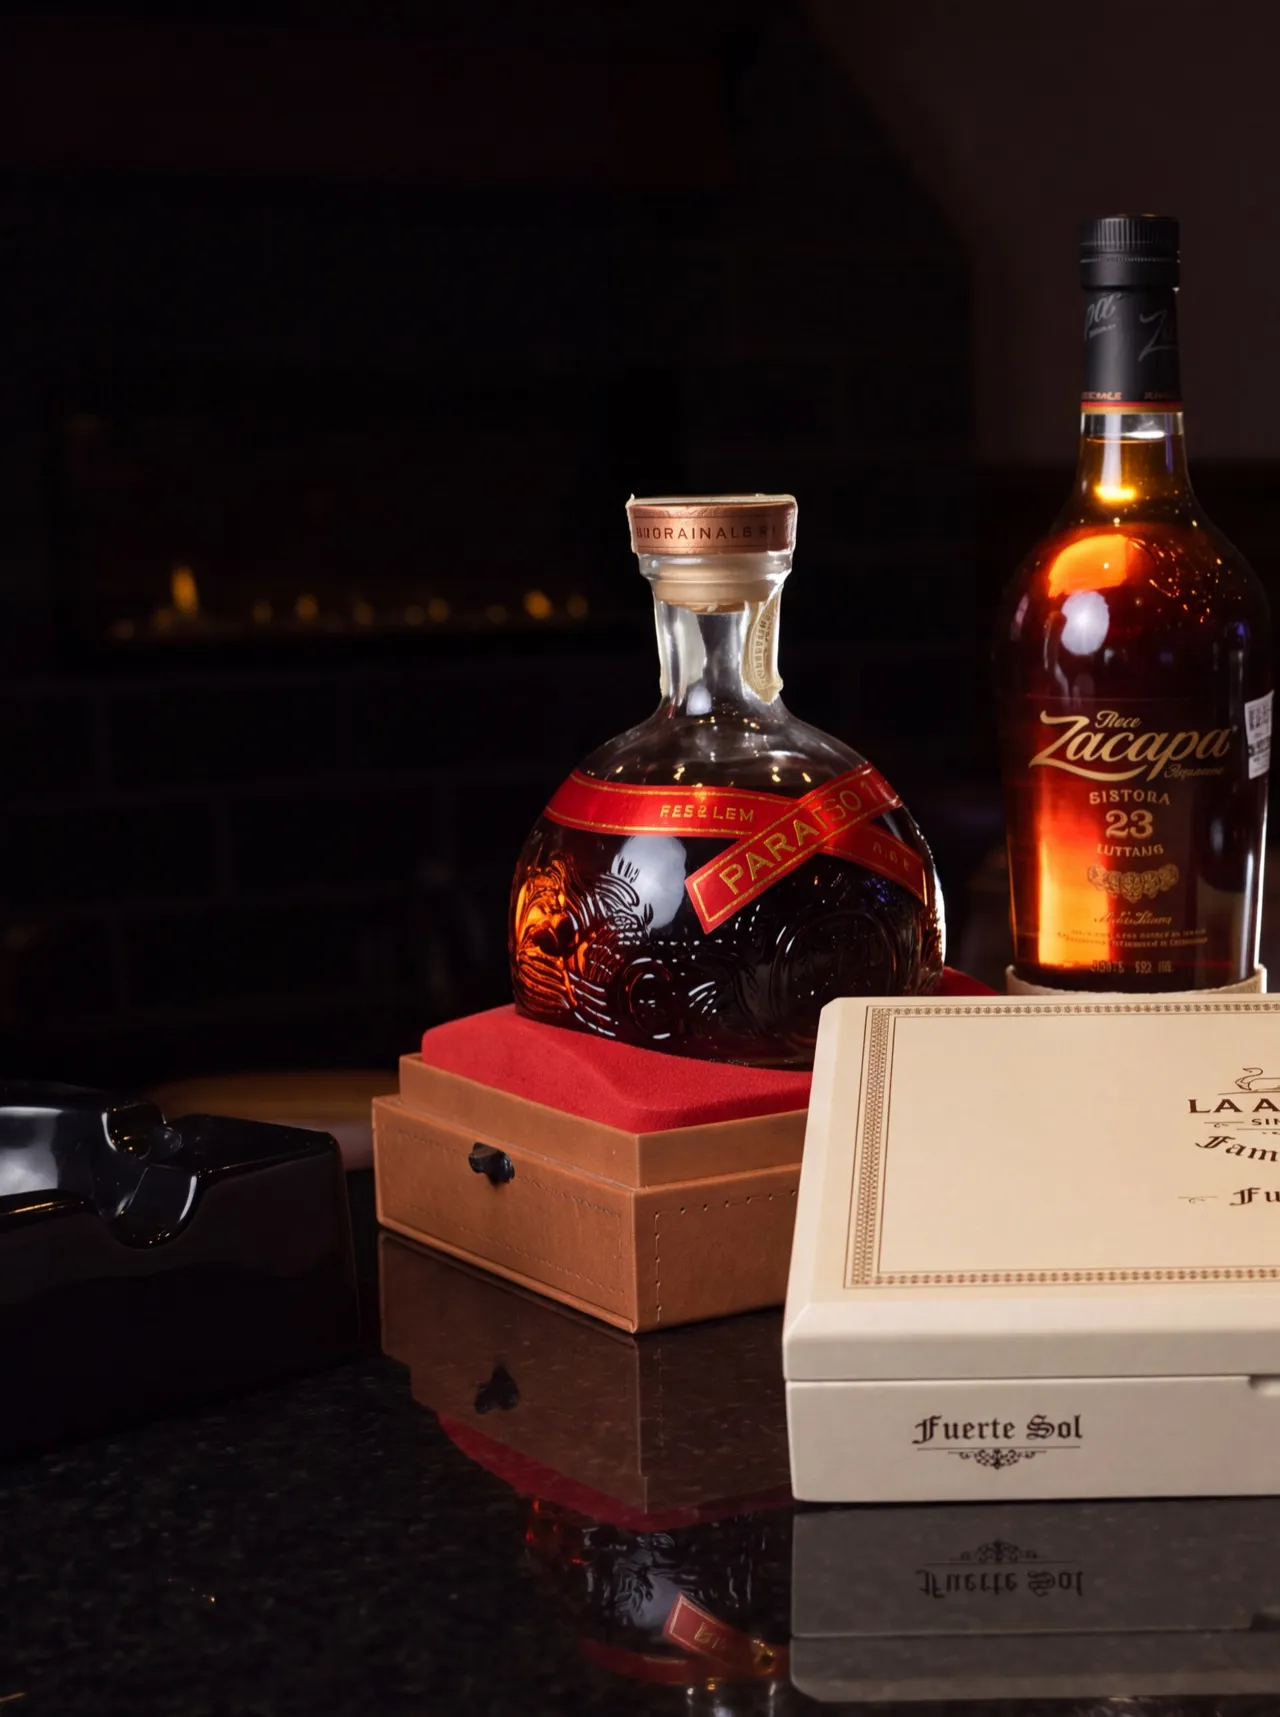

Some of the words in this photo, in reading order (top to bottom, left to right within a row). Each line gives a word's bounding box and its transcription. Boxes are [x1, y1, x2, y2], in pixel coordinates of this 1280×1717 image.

[1028, 710, 1231, 782] Zacapa
[1105, 809, 1153, 839] 23
[1188, 1098, 1244, 1114] LA
[912, 1414, 1016, 1445] Fuerte
[1026, 1414, 1083, 1440] Sol
